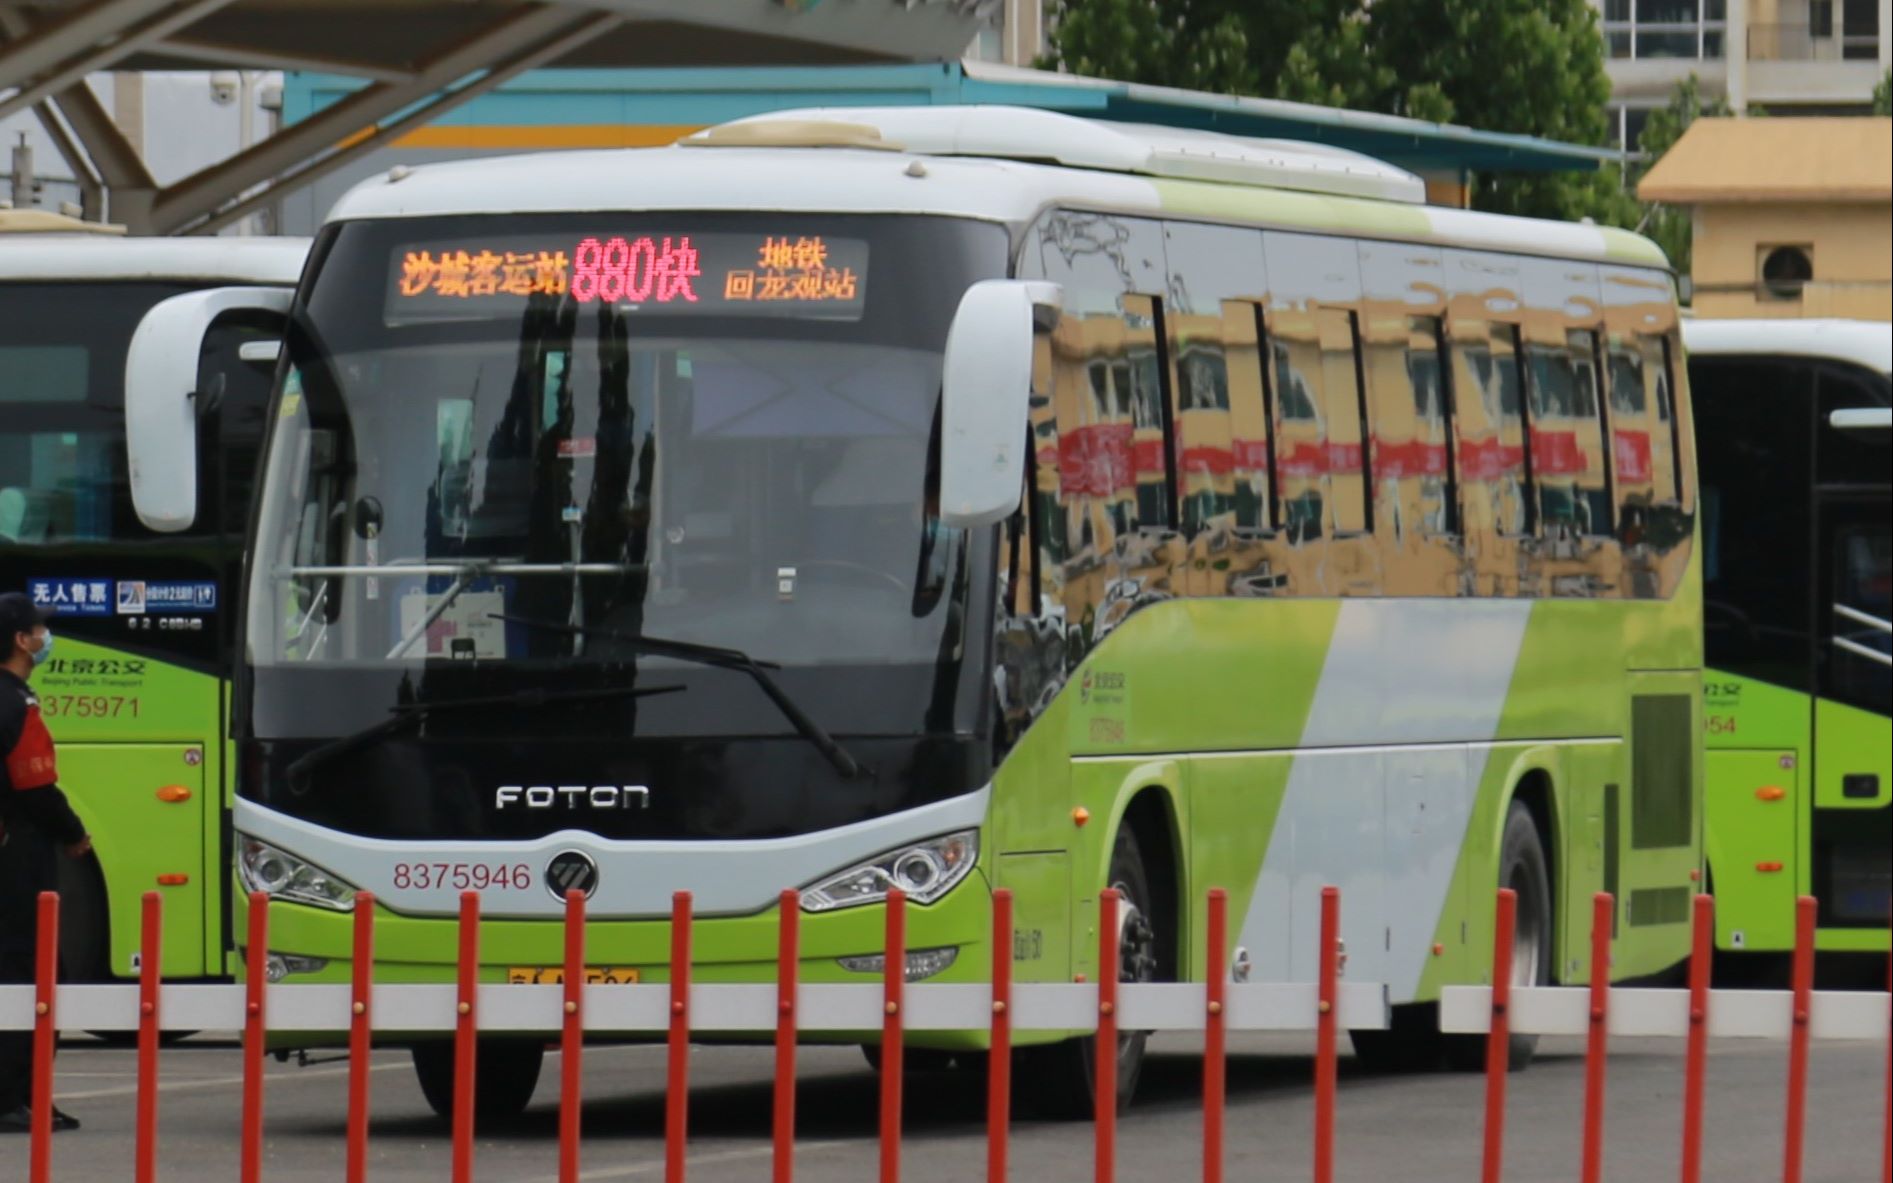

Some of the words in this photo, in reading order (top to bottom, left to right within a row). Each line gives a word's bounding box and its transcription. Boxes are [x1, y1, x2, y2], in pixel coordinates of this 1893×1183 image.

[758, 236, 827, 270] 地铁
[401, 250, 568, 297] 沙城客运站
[571, 236, 700, 302] 880快
[724, 267, 857, 300] 回龙观站
[33, 583, 106, 603] 无人售票
[46, 659, 145, 675] 北京公交
[40, 695, 139, 717] 375971
[495, 786, 649, 809] FOTON
[393, 864, 531, 889] 8375946
